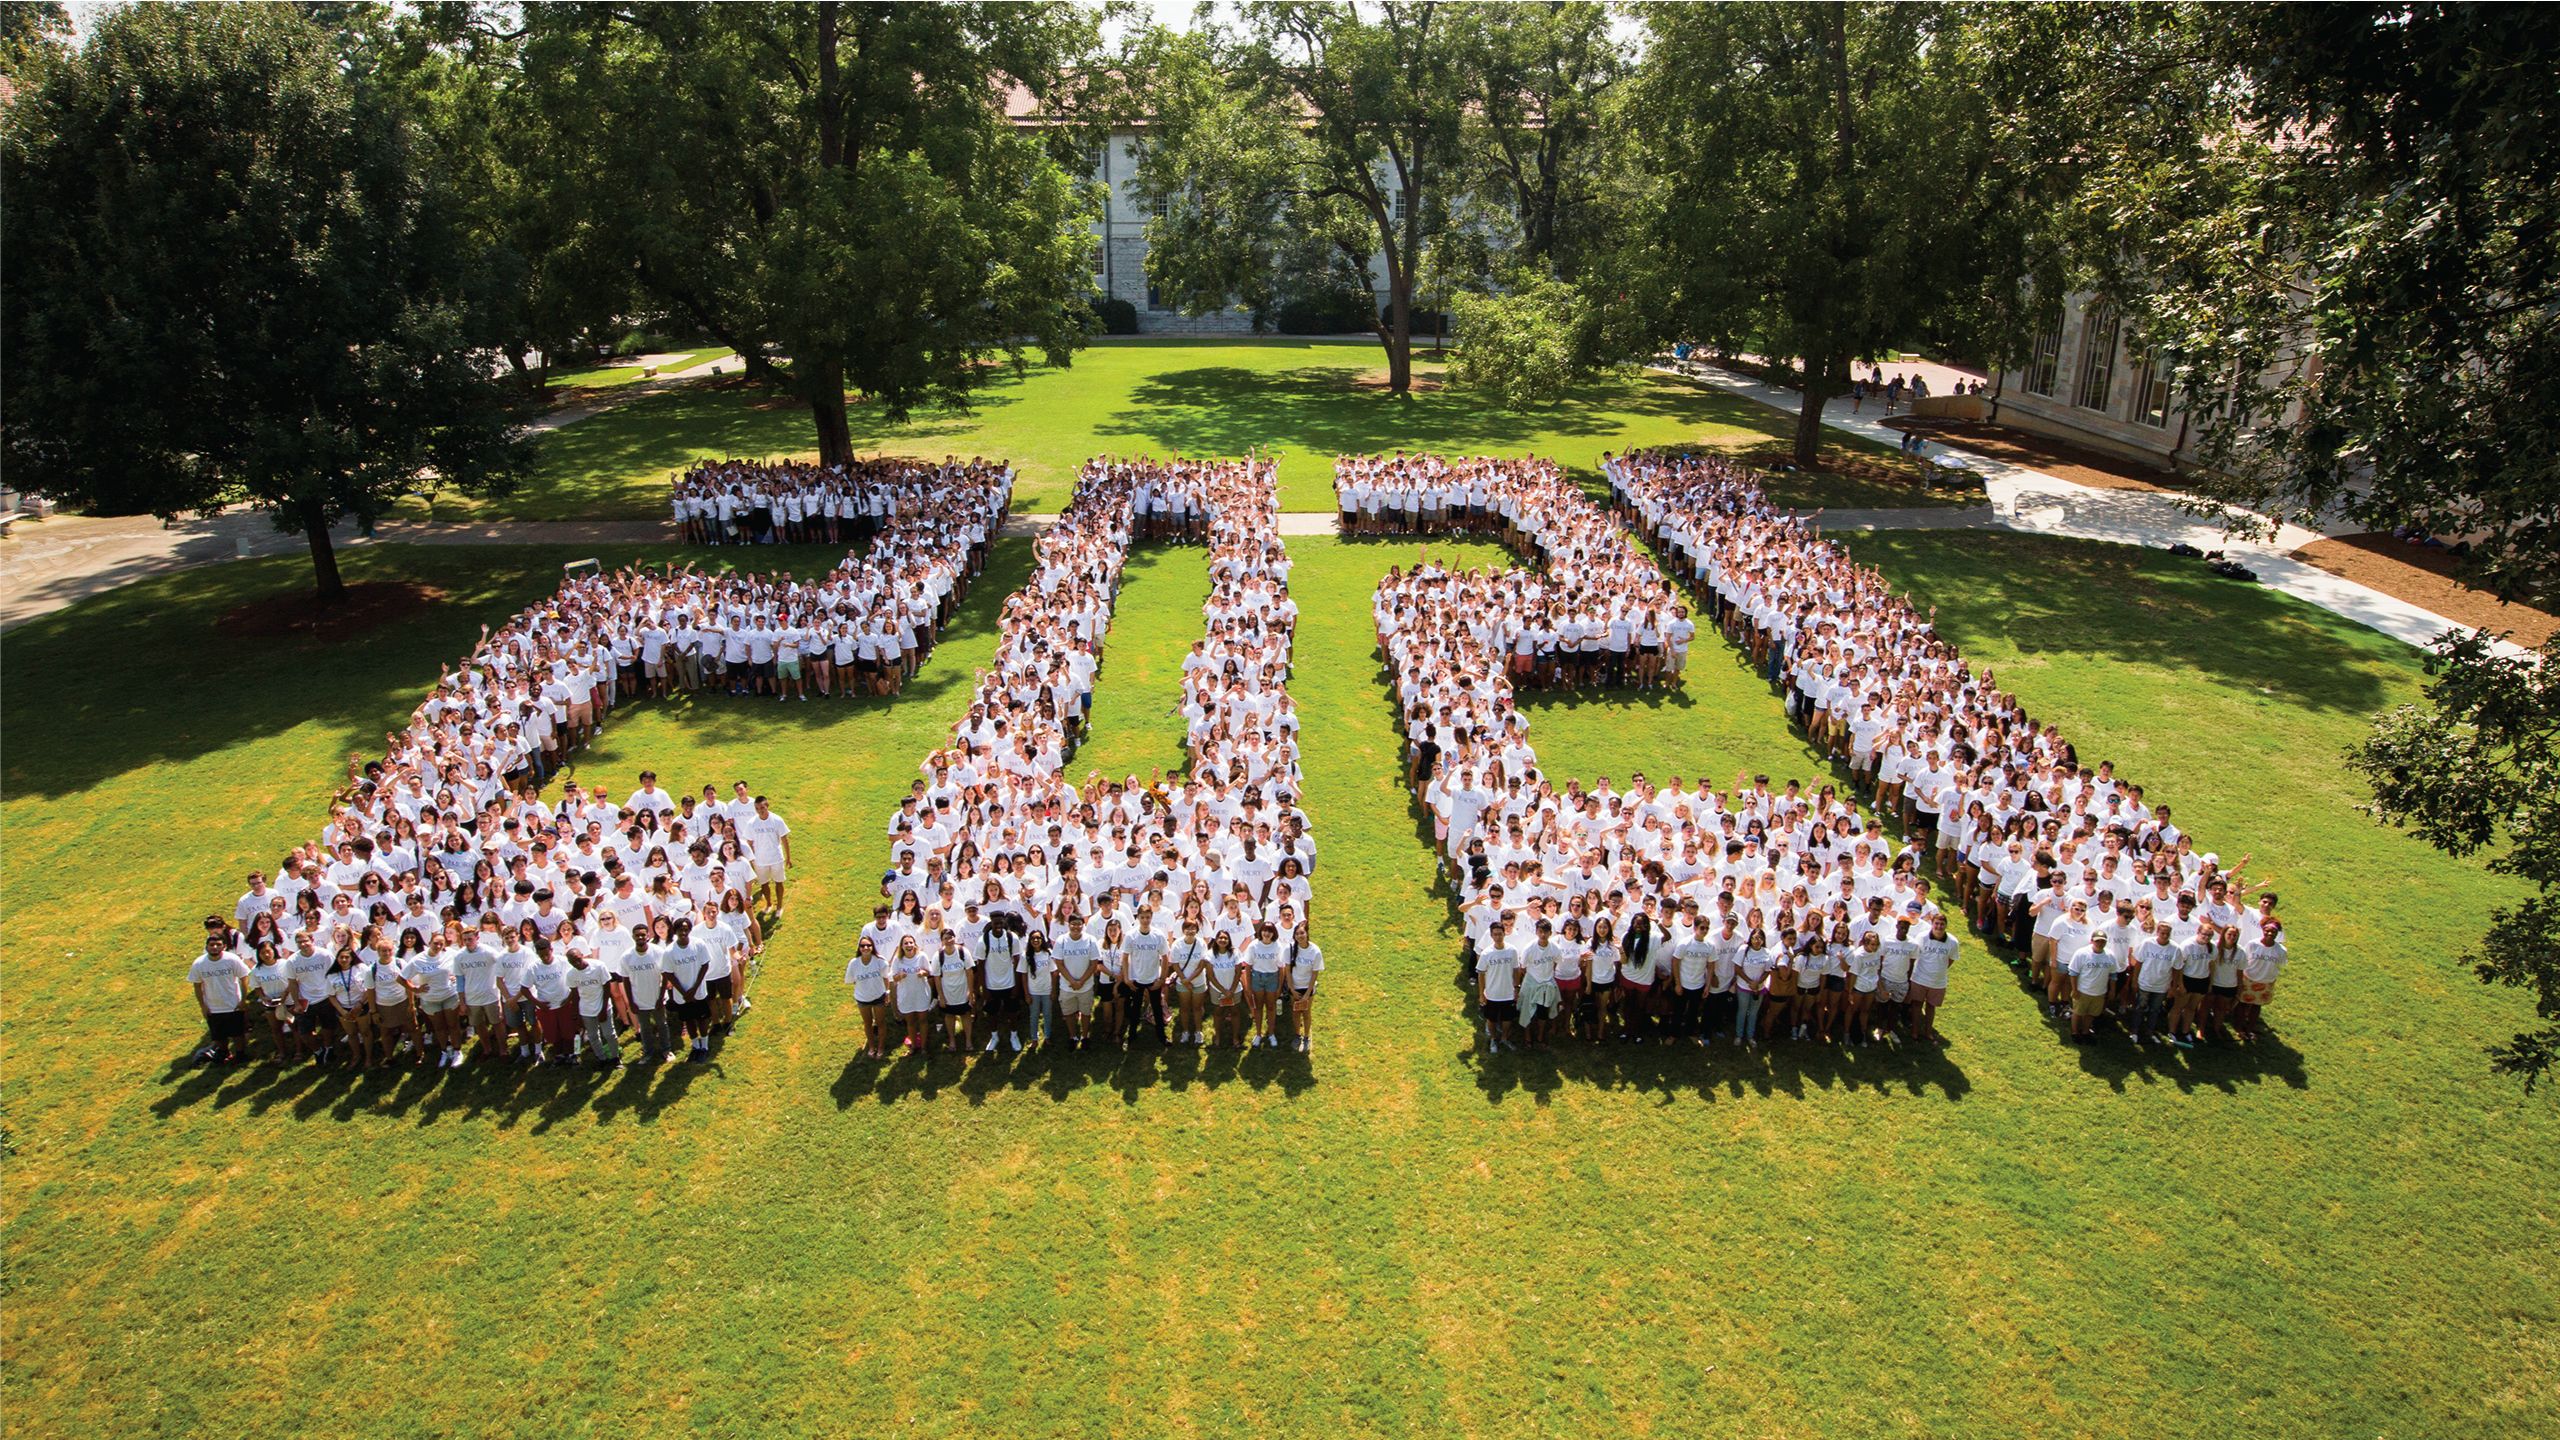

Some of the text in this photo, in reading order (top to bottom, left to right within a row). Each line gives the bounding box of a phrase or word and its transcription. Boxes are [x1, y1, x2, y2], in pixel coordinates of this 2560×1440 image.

[2146, 951, 2172, 961] EMORY
[296, 963, 324, 973] EMORY
[201, 969, 232, 977] EMORY
[856, 971, 880, 980] EMORY
